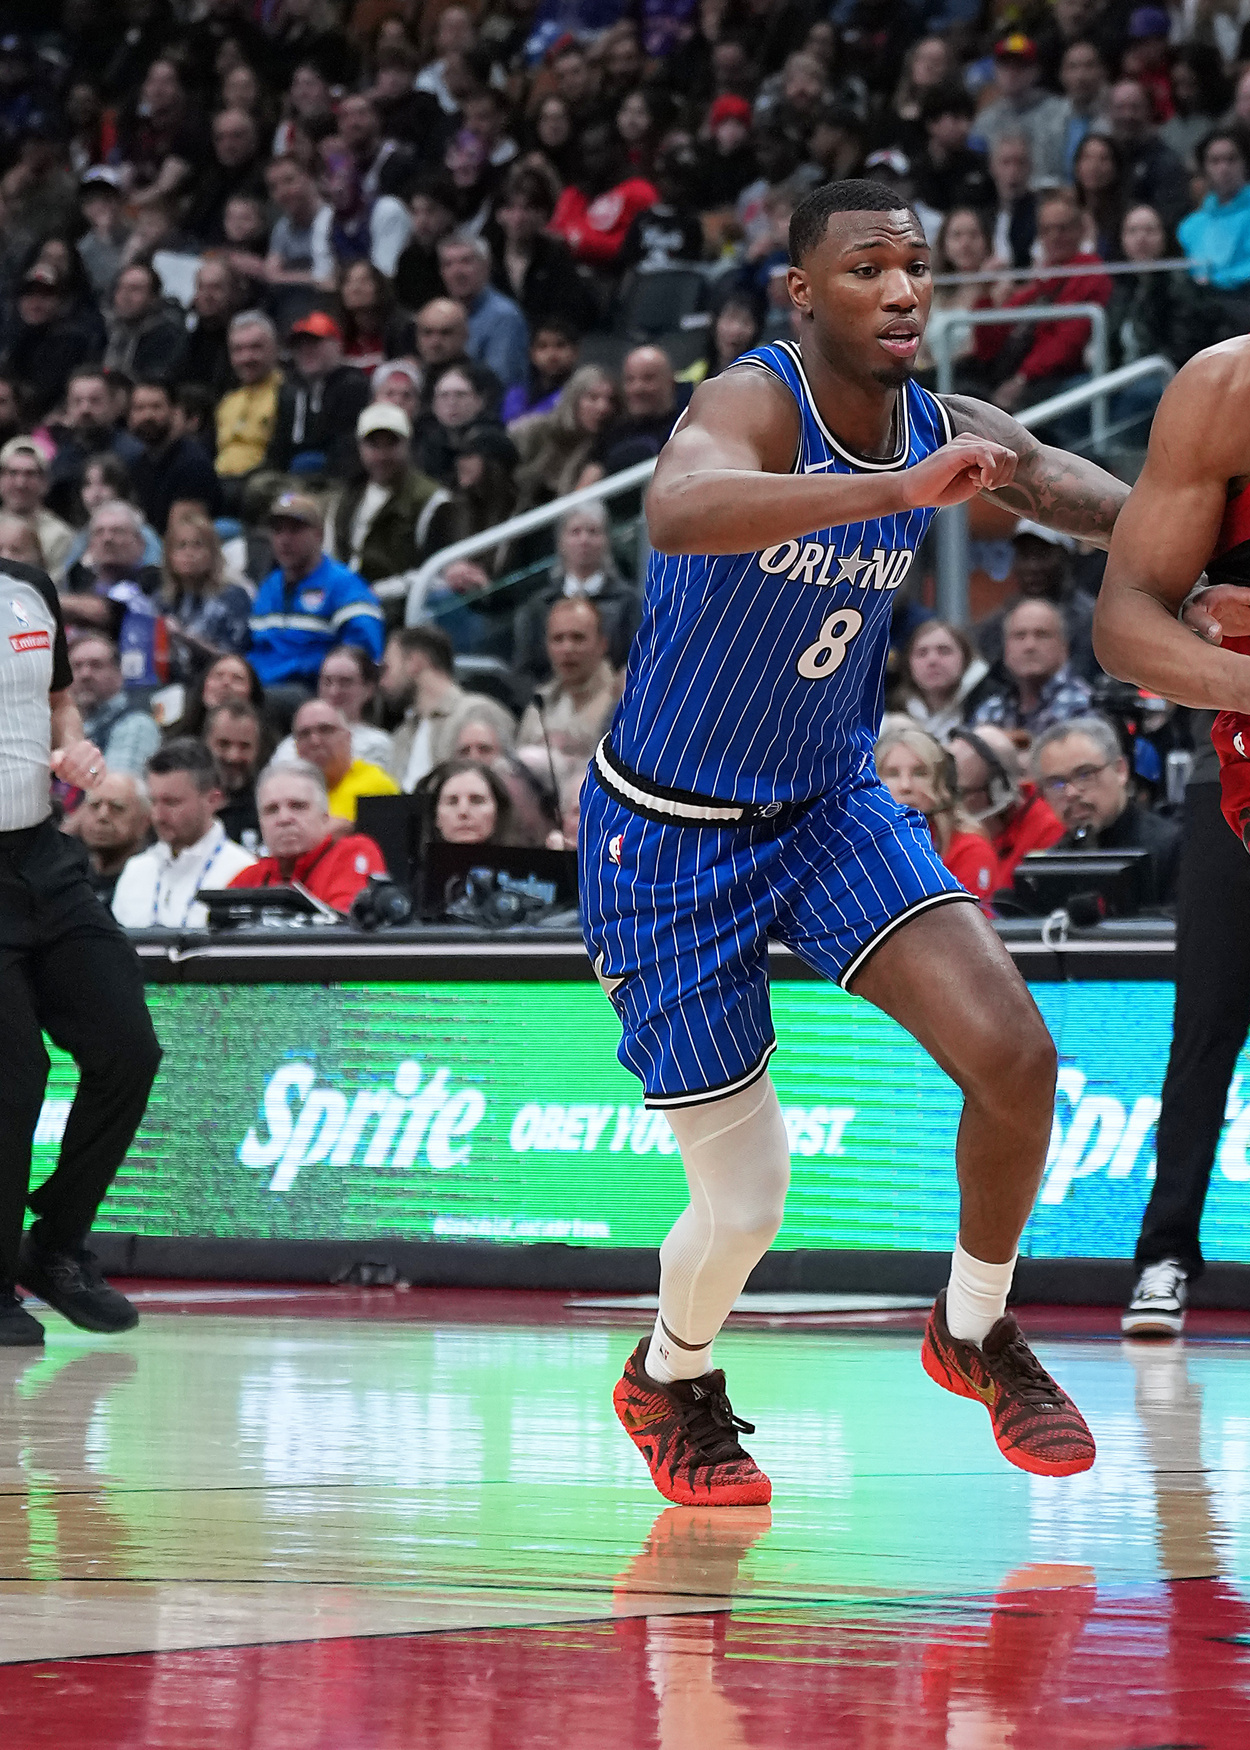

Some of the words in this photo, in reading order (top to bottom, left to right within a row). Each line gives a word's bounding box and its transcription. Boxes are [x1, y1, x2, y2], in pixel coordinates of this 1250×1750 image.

[796, 607, 863, 680] 8
[237, 1060, 487, 1191] Sprite
[509, 1102, 615, 1152] OBEY
[609, 1104, 682, 1155] YOU
